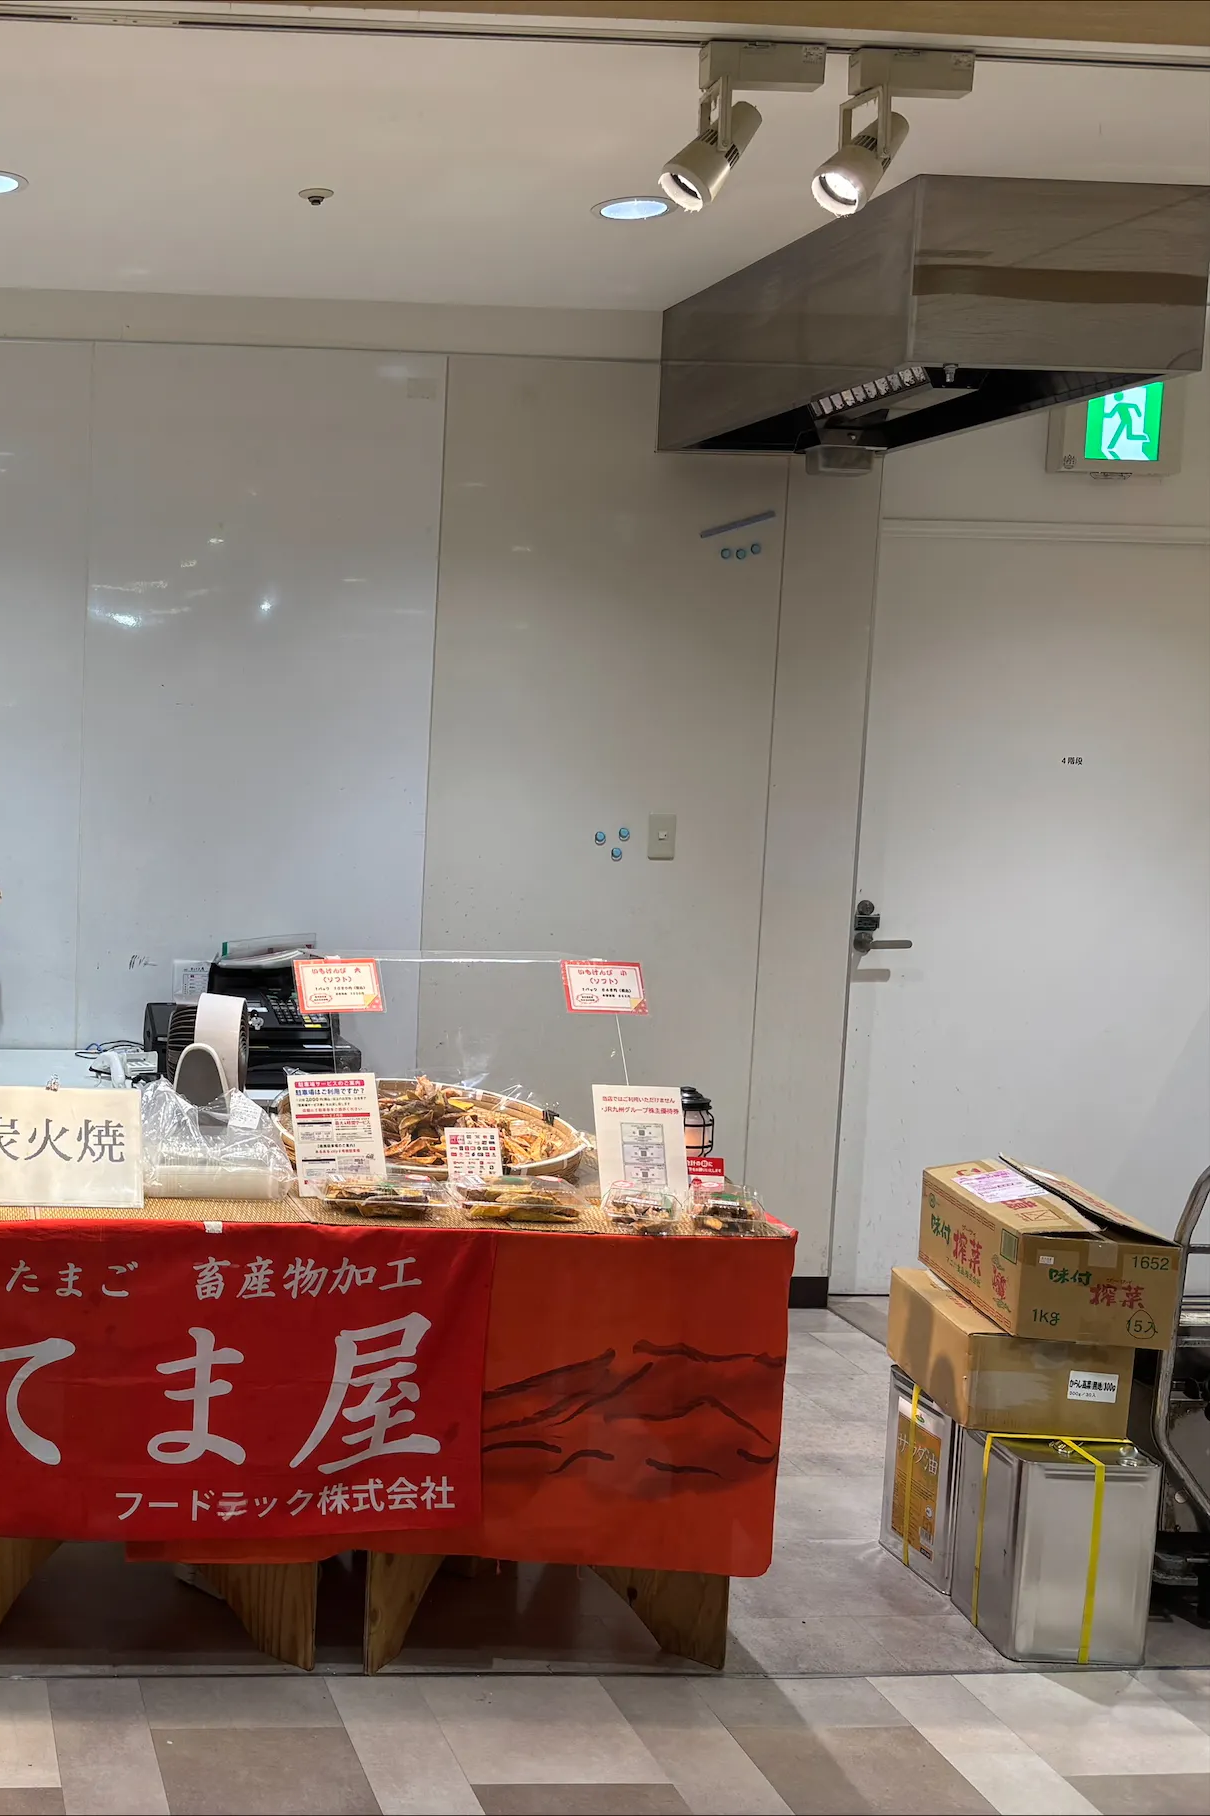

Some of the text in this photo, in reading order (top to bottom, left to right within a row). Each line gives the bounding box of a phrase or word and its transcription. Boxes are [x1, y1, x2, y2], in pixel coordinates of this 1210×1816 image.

[295, 1088, 365, 1096] 駐車場はご利用ですか？
[602, 1095, 675, 1104] 当店ではご利用いただけません
[930, 1213, 951, 1245] 味付
[953, 1229, 983, 1277] 搾菜
[1132, 1256, 1170, 1271] 1652
[193, 1255, 423, 1300] 畜産物加工
[1048, 1268, 1092, 1286] 味付
[1089, 1284, 1145, 1309] 搾菜
[1032, 1309, 1060, 1326] 1kg
[115, 1475, 456, 1521] フードテック株式会社
